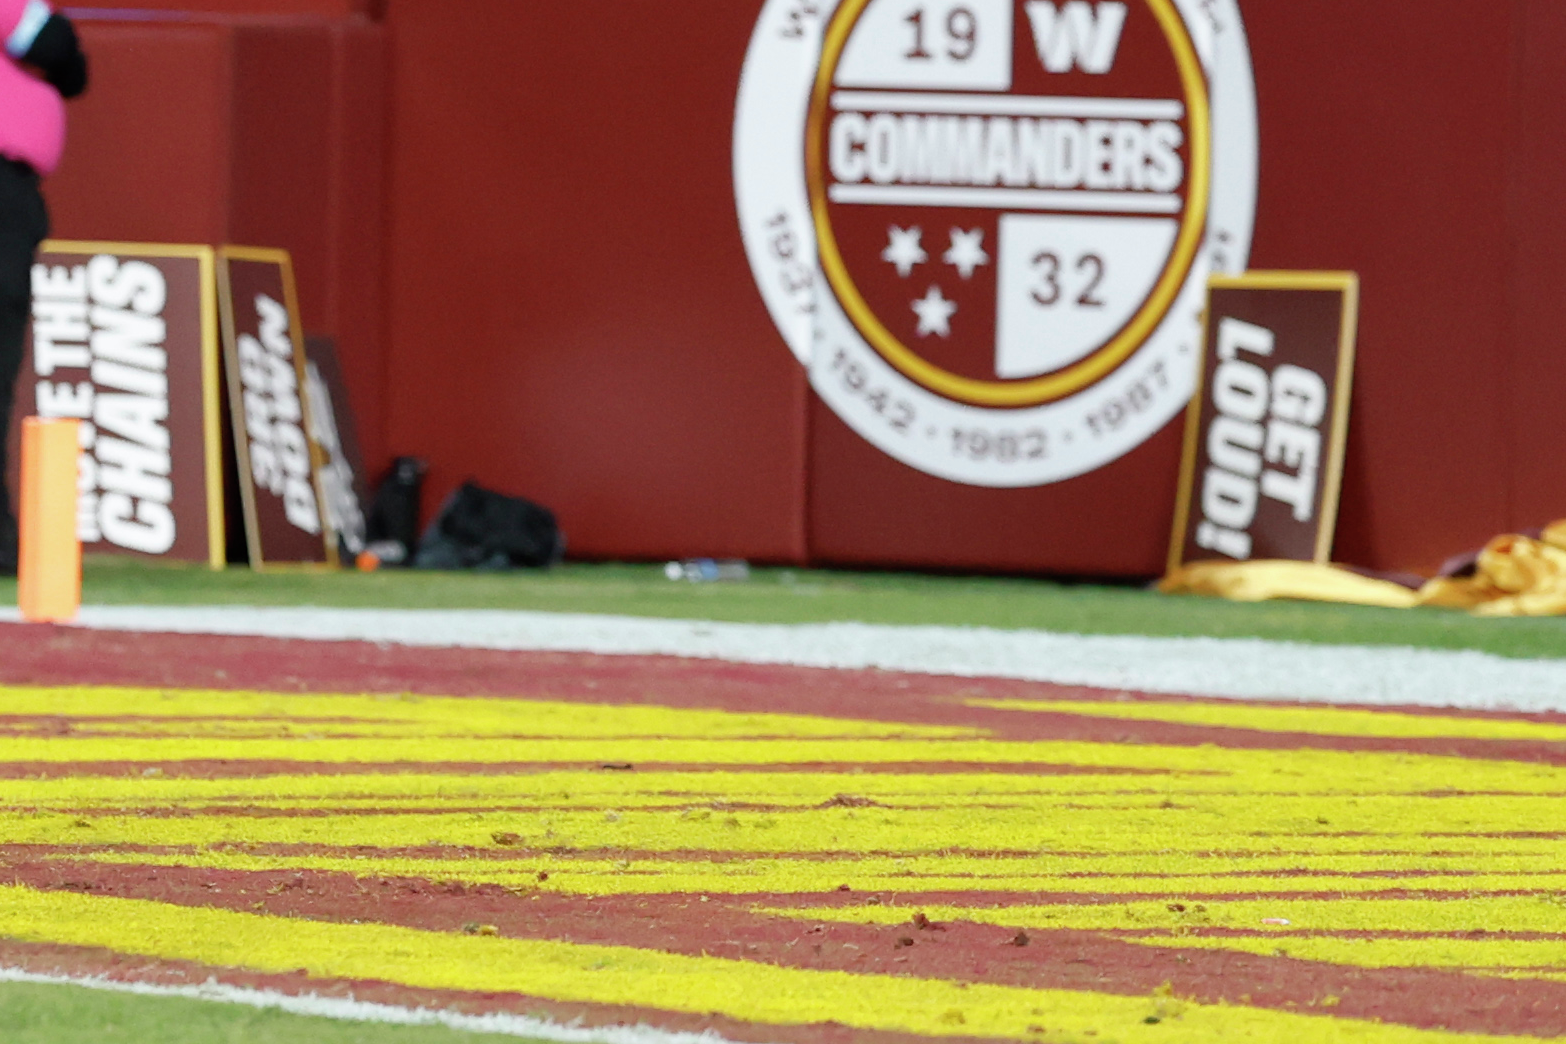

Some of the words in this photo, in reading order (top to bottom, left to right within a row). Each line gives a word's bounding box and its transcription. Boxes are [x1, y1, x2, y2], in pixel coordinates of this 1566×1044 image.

[902, 5, 977, 61] 19
[829, 111, 1184, 193] COMMANDERS
[31, 263, 93, 376] THE
[1030, 250, 1106, 308] 32
[86, 253, 177, 555] CHAINS
[830, 349, 917, 438] 1942
[1195, 316, 1275, 560] LOUD!
[1260, 363, 1327, 522] GET
